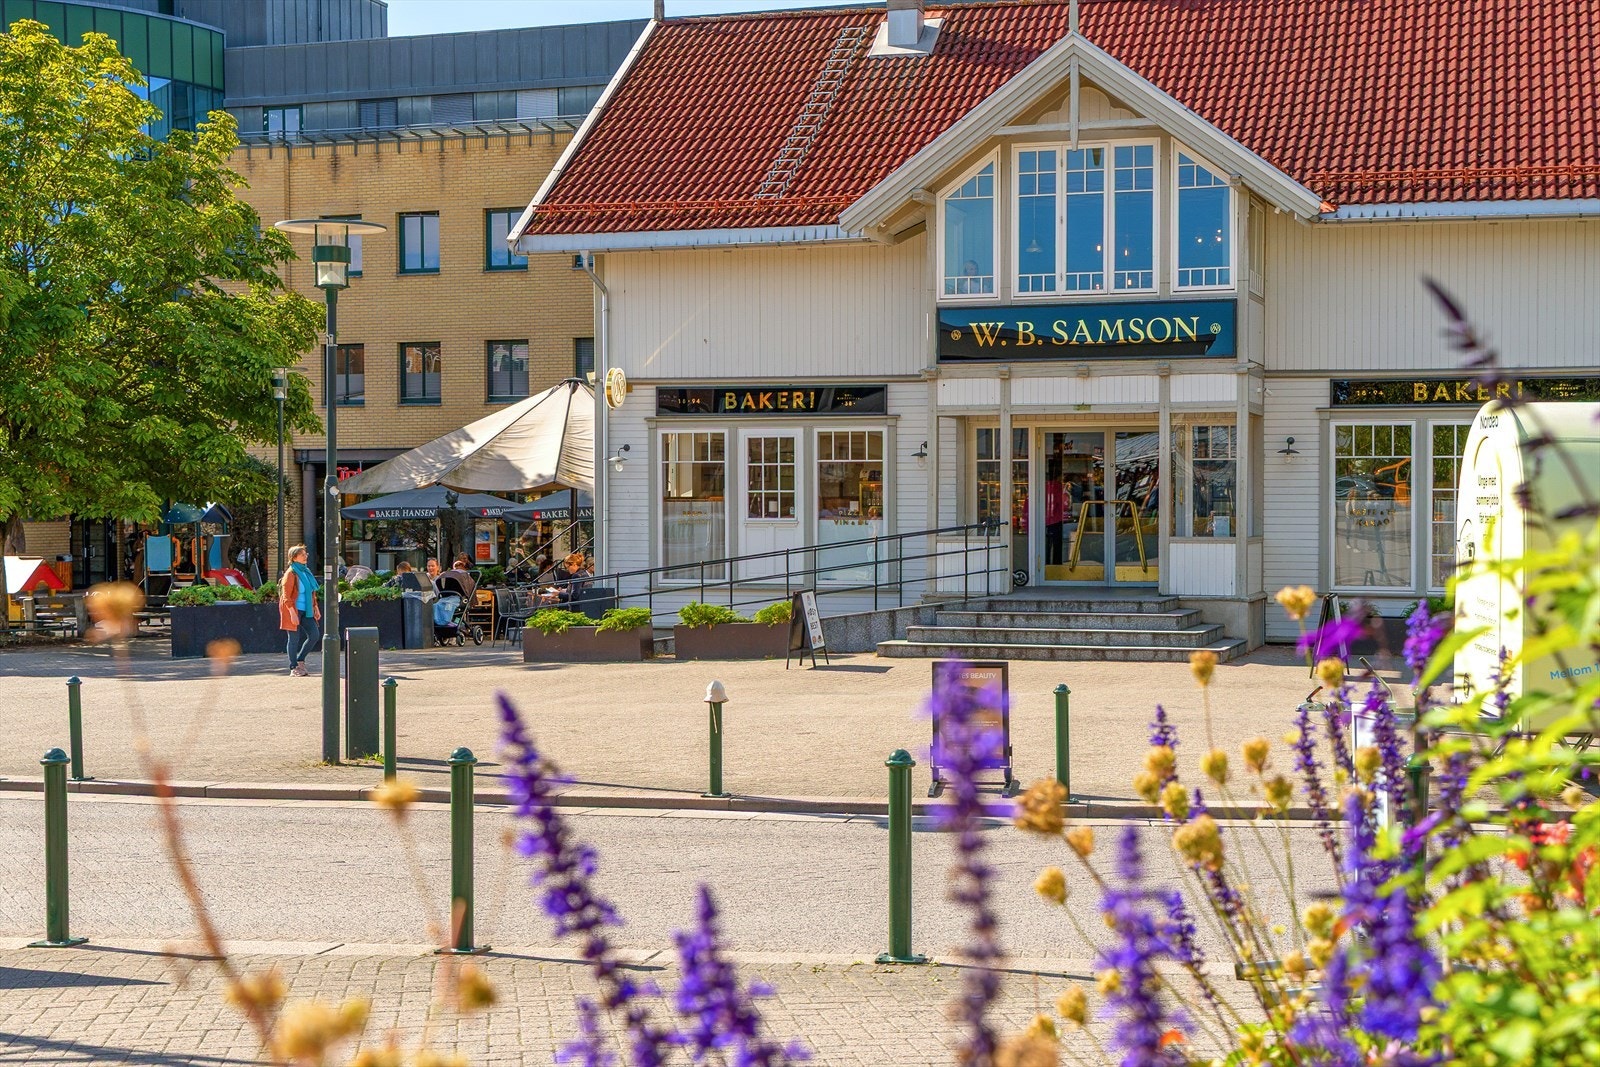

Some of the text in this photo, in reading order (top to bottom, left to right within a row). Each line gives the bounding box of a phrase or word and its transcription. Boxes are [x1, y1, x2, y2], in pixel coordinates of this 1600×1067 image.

[968, 316, 1200, 347] W. B. SAMSON
[1413, 381, 1523, 401] BAKERI
[724, 391, 815, 410] BAKERI
[375, 508, 436, 518] BAKER HANSEN
[541, 511, 569, 519] BAKER
[1550, 666, 1592, 680] Mellom
